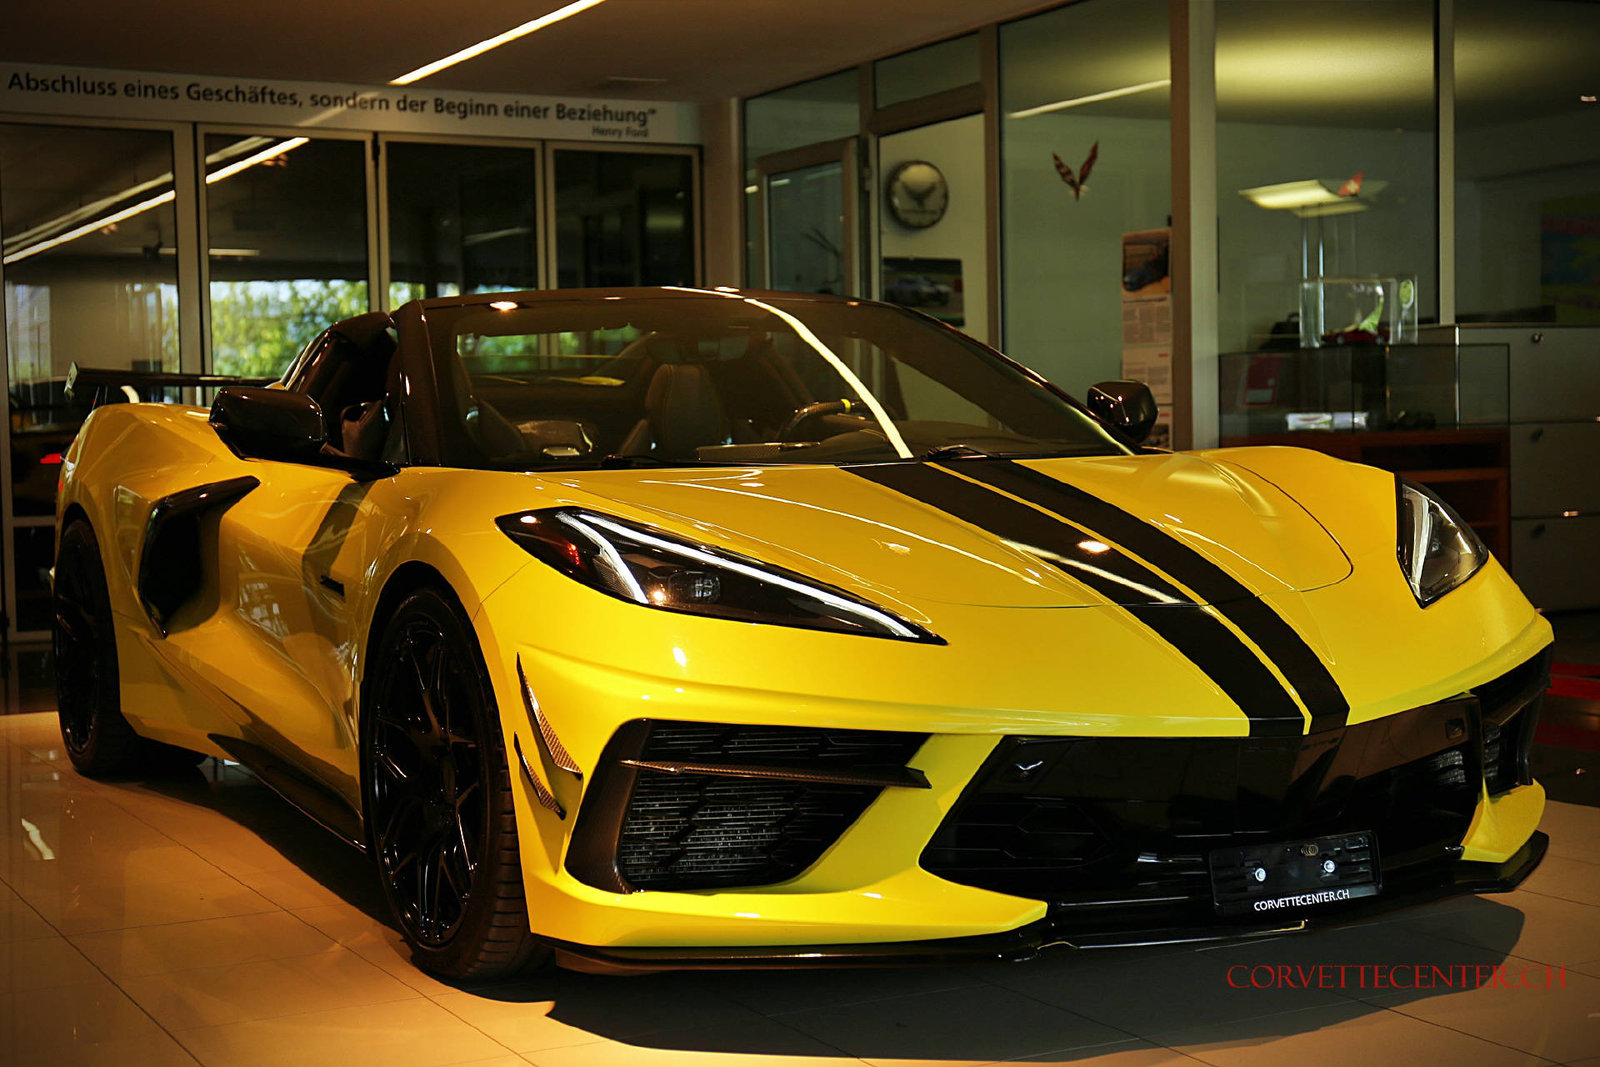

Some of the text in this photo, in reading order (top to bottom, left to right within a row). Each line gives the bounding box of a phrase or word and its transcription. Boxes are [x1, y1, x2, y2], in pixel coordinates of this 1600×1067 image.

[8, 72, 117, 97] Abschluss
[123, 79, 180, 100] eines
[186, 83, 303, 107] Geschäftes,
[309, 92, 391, 112] sondern
[396, 94, 427, 113] der
[434, 97, 498, 120] Beginn
[503, 99, 551, 119] einer
[1253, 889, 1350, 912] CORVETTECENTER.CH
